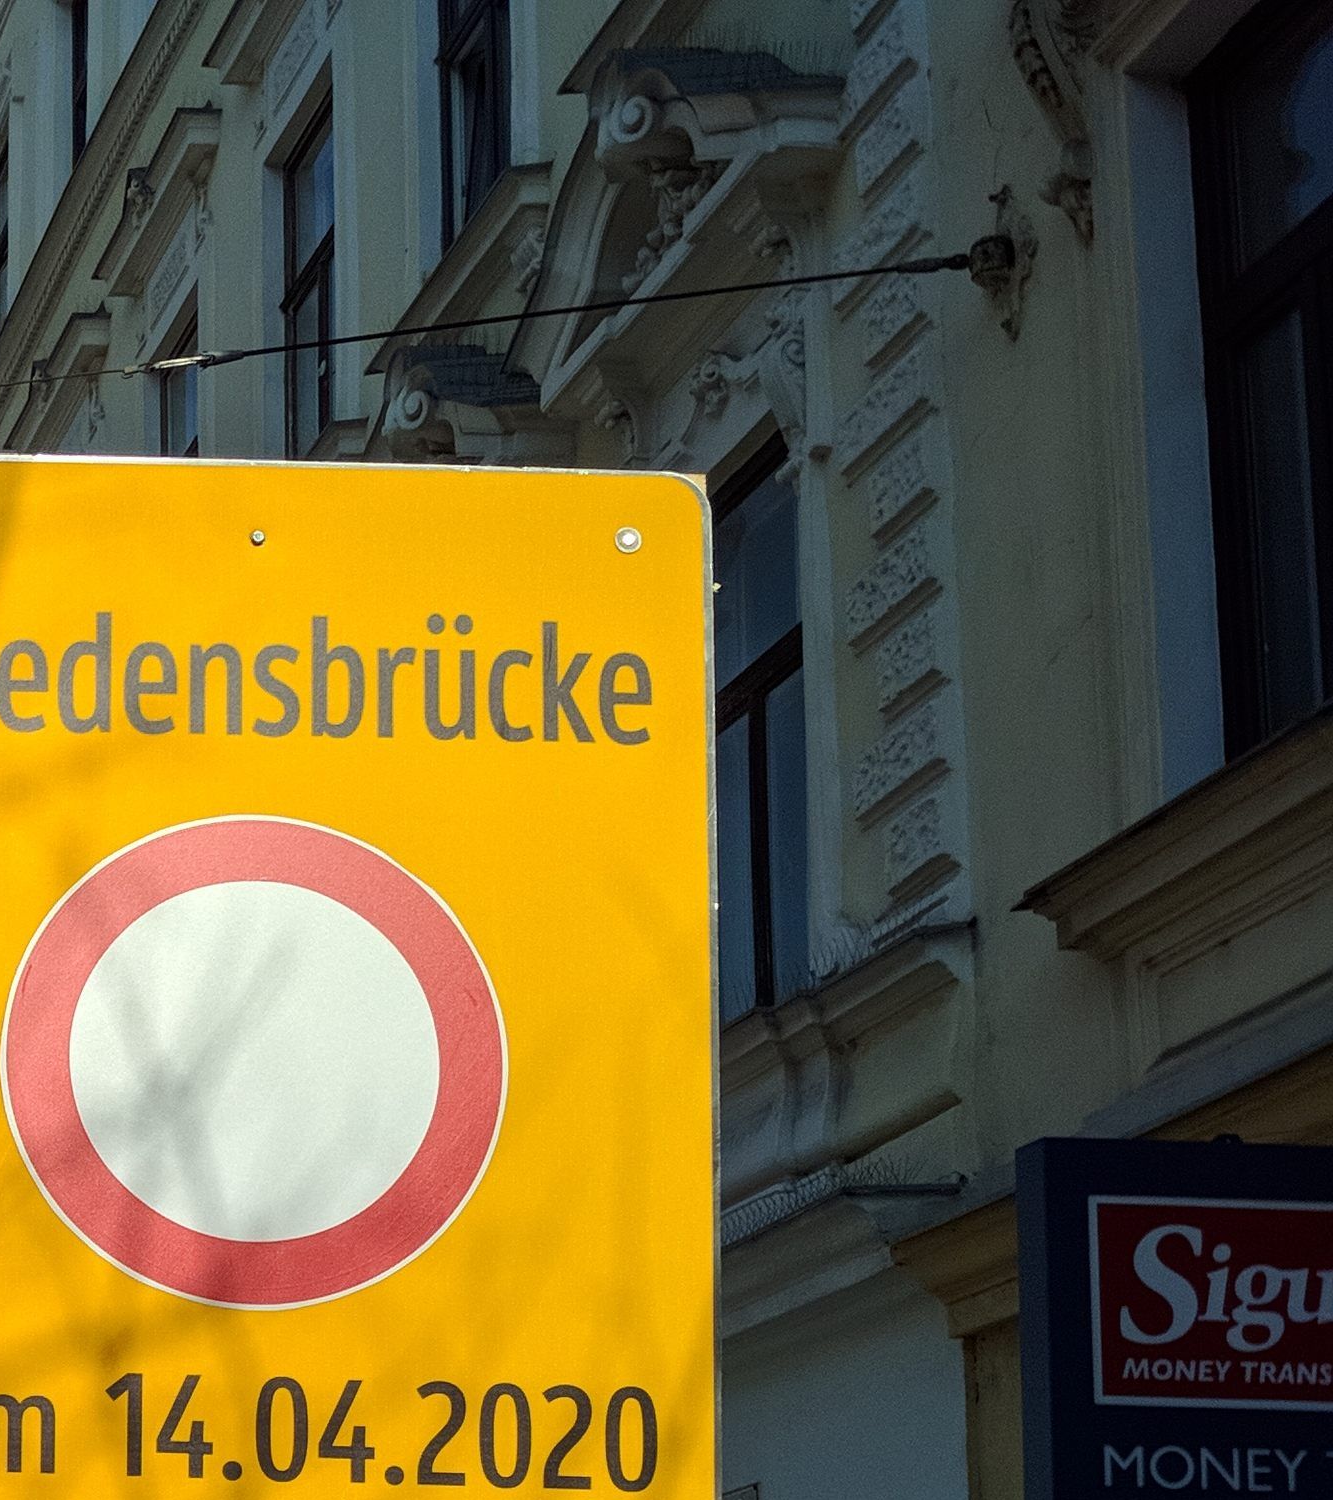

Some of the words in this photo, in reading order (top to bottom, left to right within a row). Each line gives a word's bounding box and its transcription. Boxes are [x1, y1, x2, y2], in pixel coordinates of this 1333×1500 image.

[1121, 1356, 1233, 1384] MONEY
[1240, 1360, 1333, 1387] TRANS
[105, 1371, 660, 1494] 14.04.2020
[1101, 1443, 1309, 1493] MONEY
